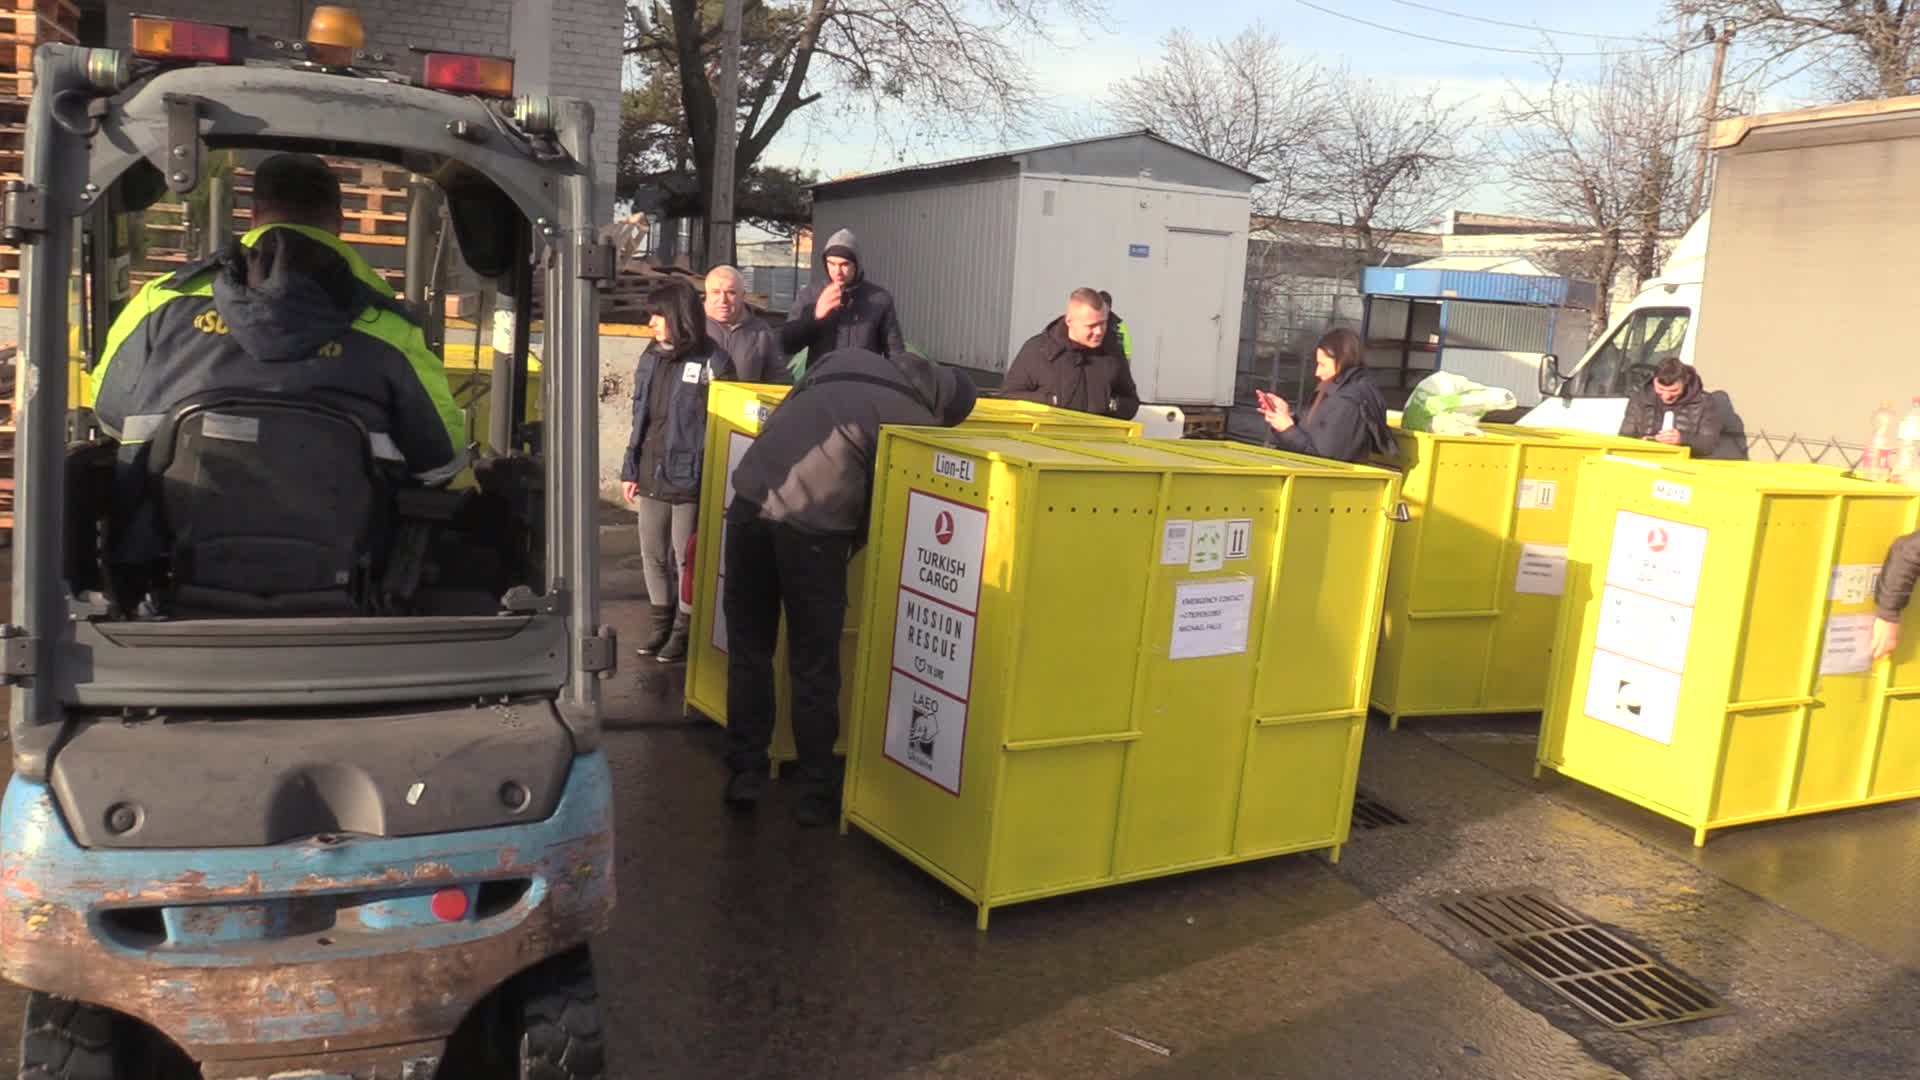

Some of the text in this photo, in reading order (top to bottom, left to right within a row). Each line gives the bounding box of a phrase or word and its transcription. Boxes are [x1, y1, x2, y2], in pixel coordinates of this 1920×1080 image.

[935, 453, 971, 481] Lion-EL
[917, 547, 966, 578] TURKISH
[919, 567, 959, 593] CARGO
[906, 600, 962, 640] MISSION
[907, 624, 957, 661] RESCUE
[913, 688, 939, 712] LAEO
